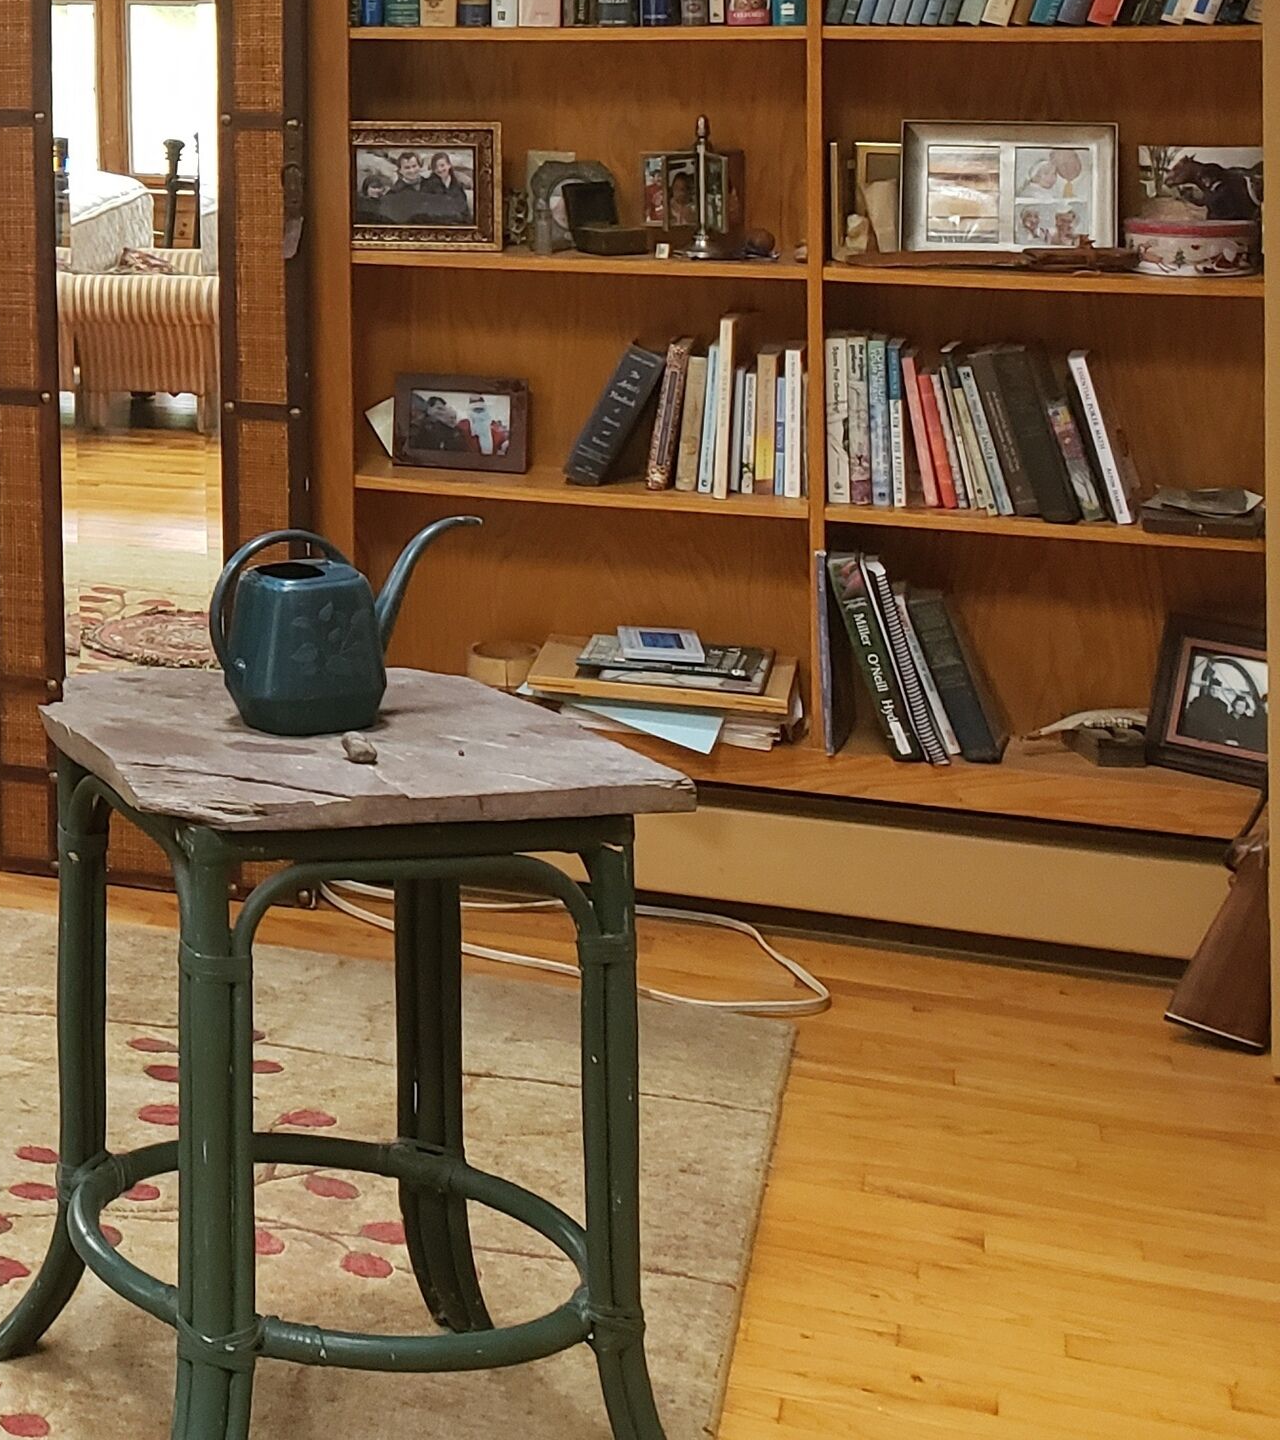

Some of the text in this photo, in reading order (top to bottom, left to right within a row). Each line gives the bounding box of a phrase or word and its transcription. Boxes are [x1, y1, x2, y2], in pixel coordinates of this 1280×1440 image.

[1075, 366, 1107, 450] ESSENTIAL POKER MATH
[981, 436, 994, 460] ANGER
[853, 612, 872, 647] Miller
[867, 652, 889, 693] O'Neill
[880, 698, 899, 723] Hyd
